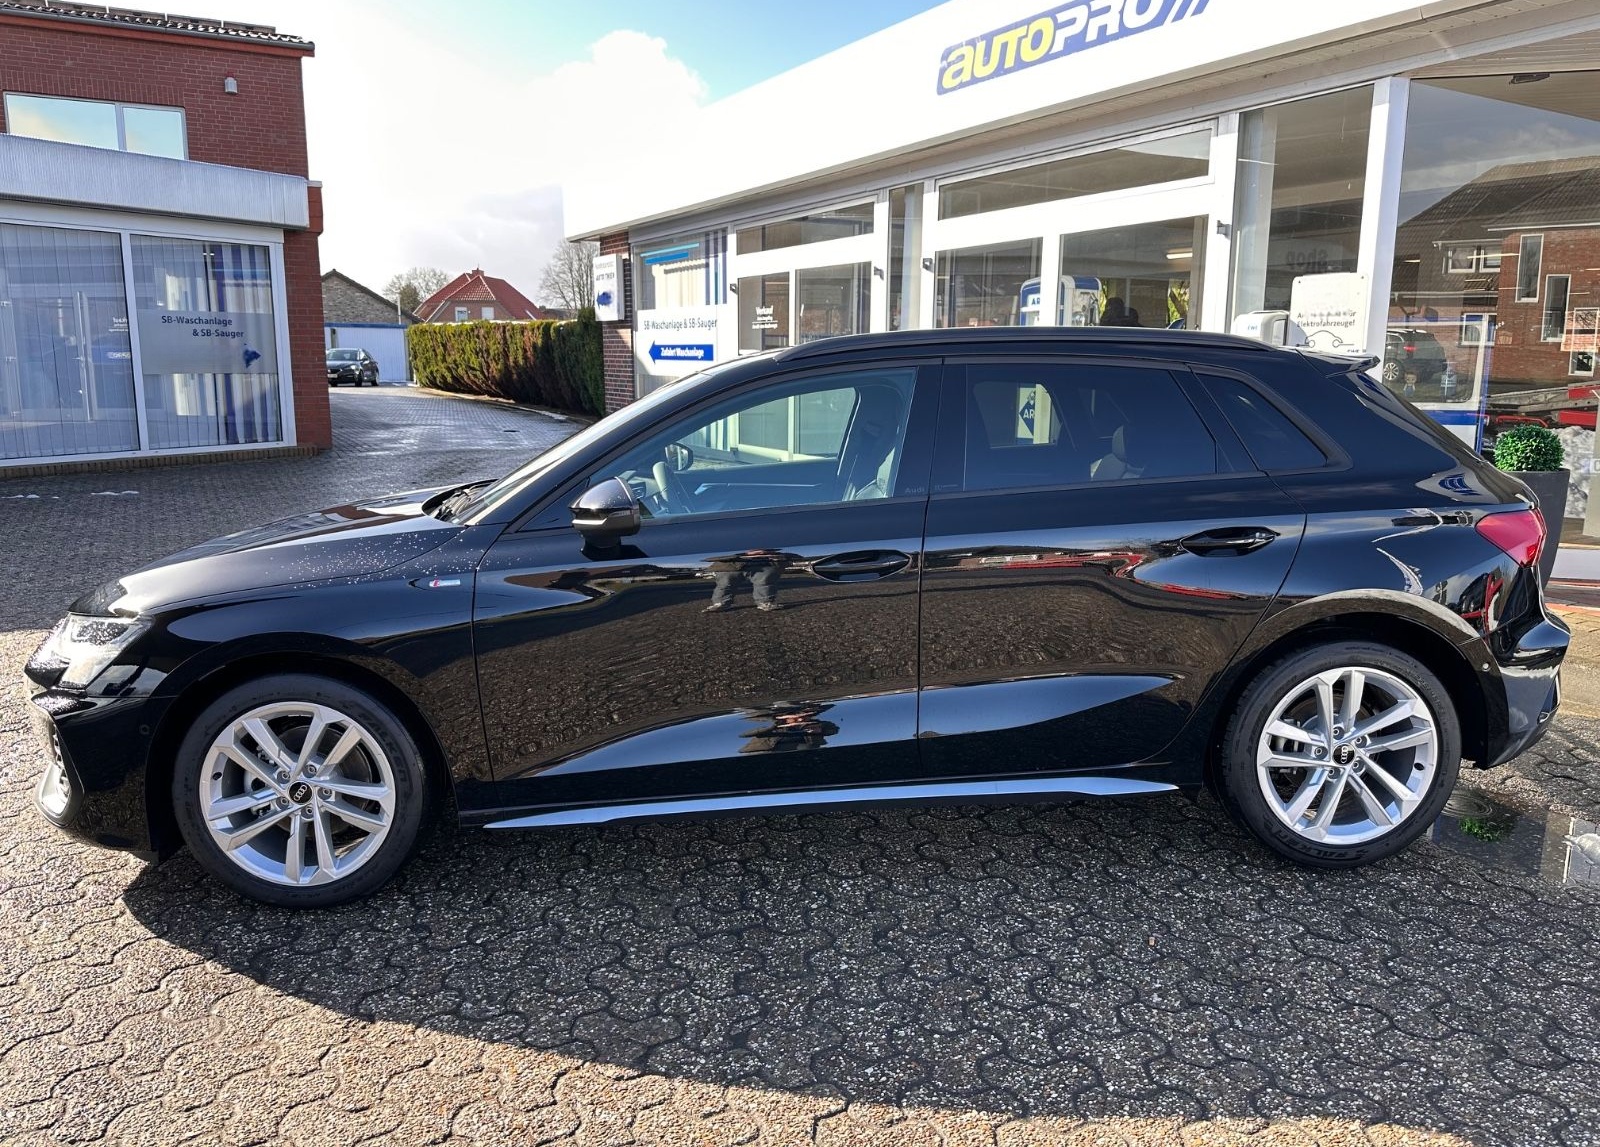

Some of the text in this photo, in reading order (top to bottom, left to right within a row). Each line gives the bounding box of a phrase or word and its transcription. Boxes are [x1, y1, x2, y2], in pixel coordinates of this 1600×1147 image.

[161, 315, 233, 326] SB-Waschanlage
[643, 319, 683, 332] SB-Waschanlage
[689, 317, 717, 331] SB-Sauger
[192, 328, 244, 339] & SB-Sauger
